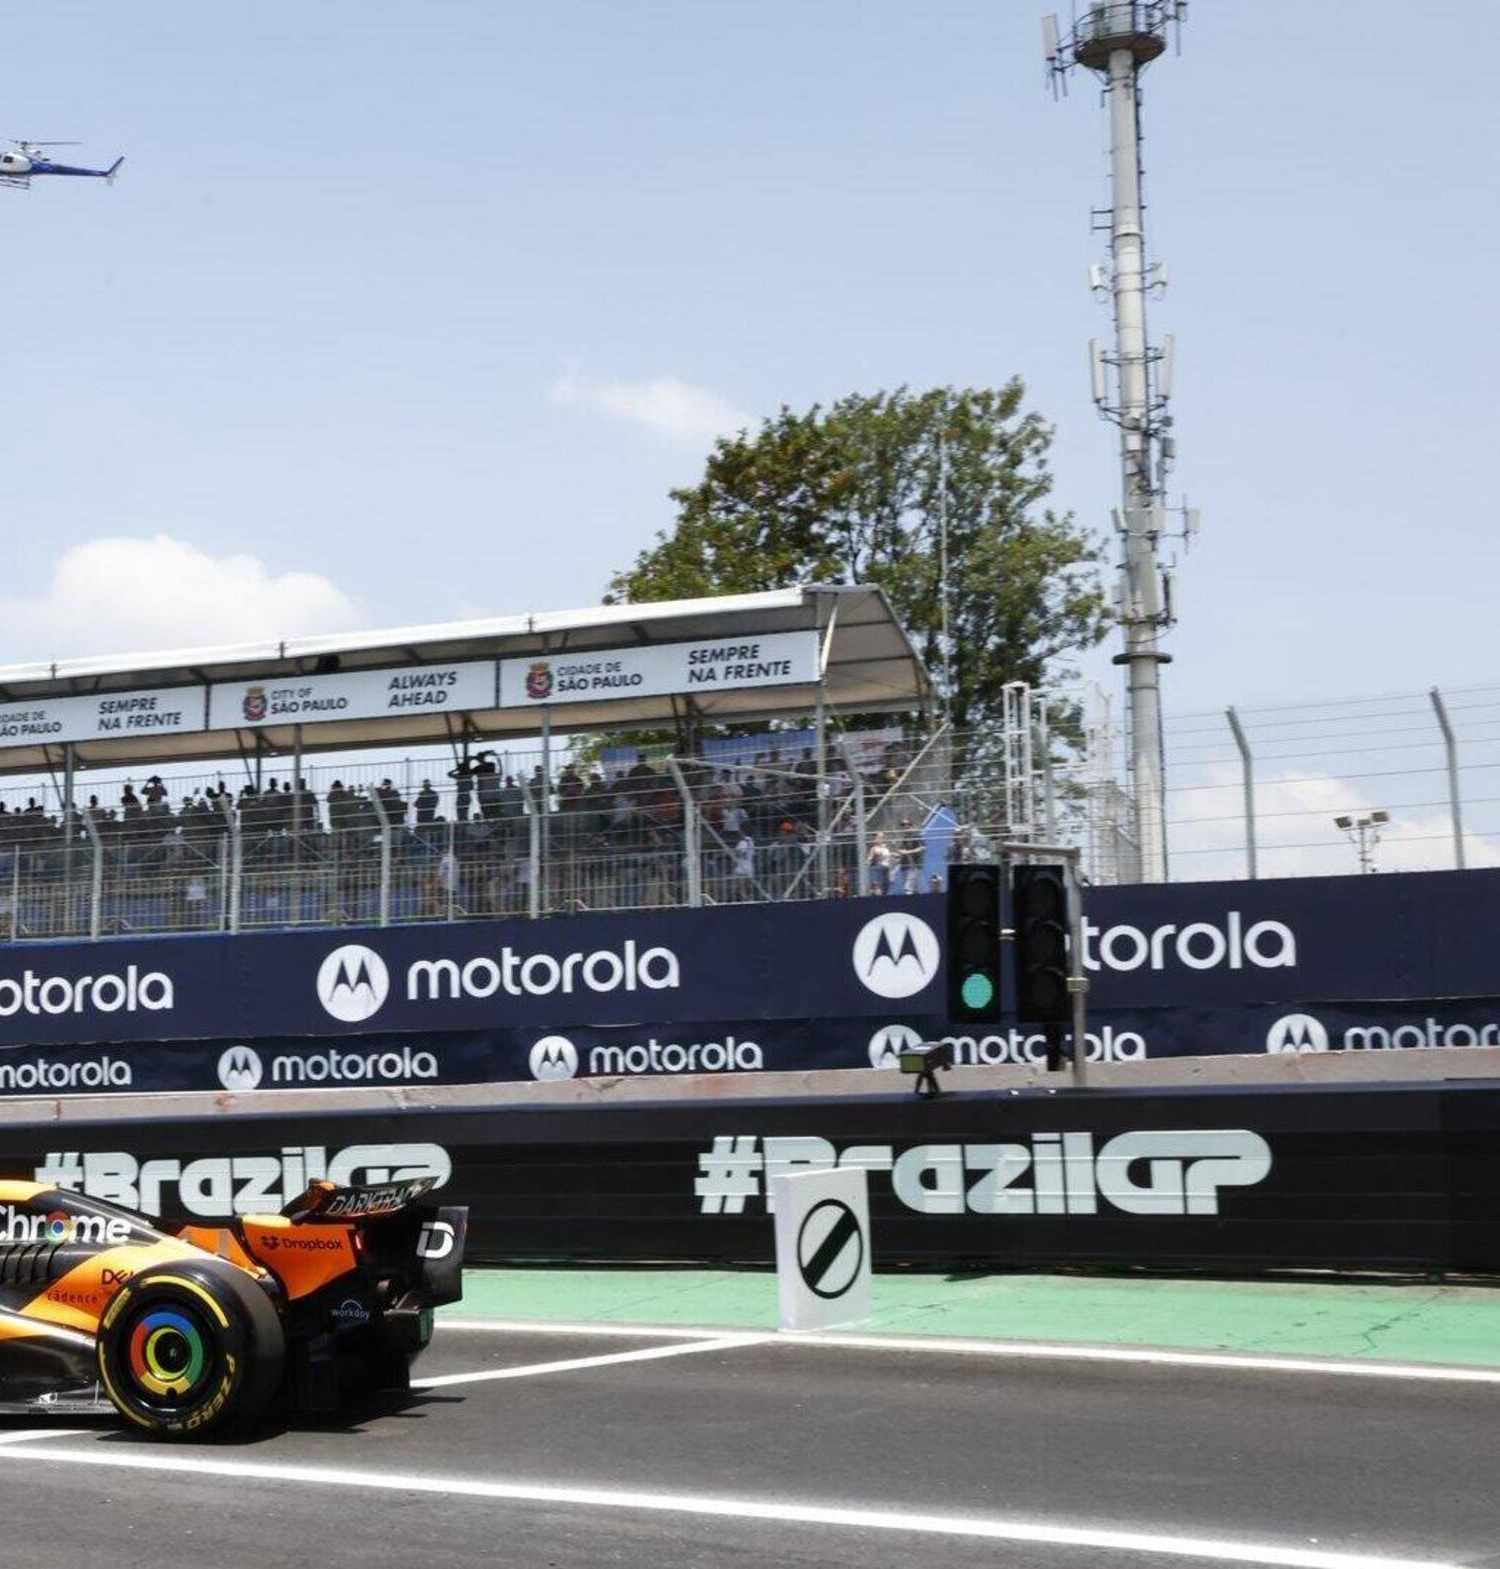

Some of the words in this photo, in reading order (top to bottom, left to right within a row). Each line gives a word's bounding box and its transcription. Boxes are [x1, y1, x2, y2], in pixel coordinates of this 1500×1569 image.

[688, 645, 760, 665] SEMPRE
[558, 664, 602, 676] CIDADE
[606, 662, 621, 673] DE
[688, 669, 718, 684] NA
[724, 660, 791, 680] FRENTE
[389, 672, 457, 691] ALWAYS
[592, 673, 642, 689] PAULO
[271, 690, 295, 700] CITY
[299, 688, 312, 698] OF
[388, 691, 447, 708] AHEAD
[97, 698, 156, 715] SEMPRE
[302, 698, 348, 711] PAULO
[32, 711, 45, 721] DE
[97, 718, 121, 731] NA
[126, 712, 182, 727] FRENTE
[20, 722, 62, 735] PAULO
[1080, 912, 1295, 971] torola
[408, 940, 679, 999] motorola
[938, 1026, 1147, 1065] motoola
[273, 1047, 437, 1081] motorola
[590, 1037, 763, 1074] motorola
[282, 1237, 344, 1251] Dropbox
